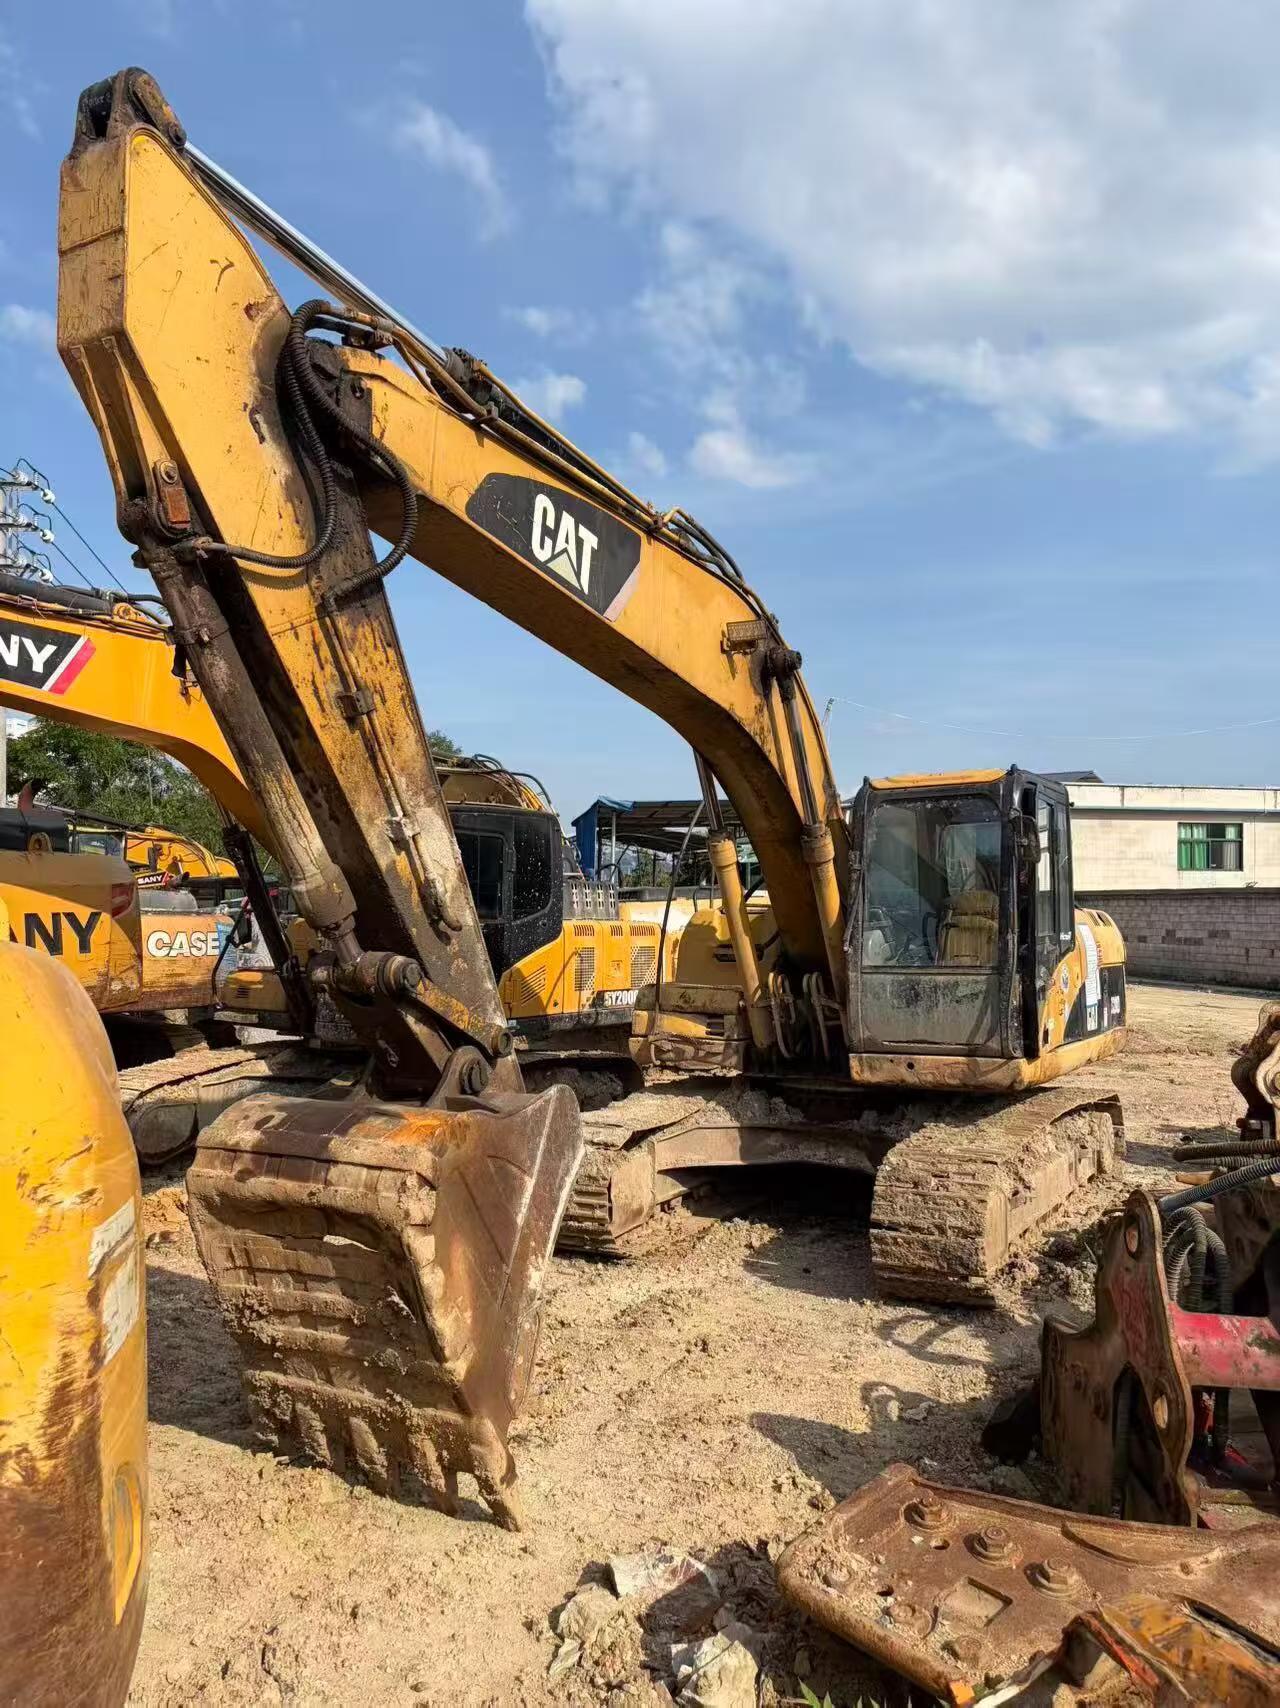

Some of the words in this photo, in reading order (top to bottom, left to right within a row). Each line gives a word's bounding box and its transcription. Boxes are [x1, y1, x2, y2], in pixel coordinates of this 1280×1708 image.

[531, 493, 598, 595] CAT
[137, 875, 162, 885] SANY
[9, 911, 102, 956] NY
[147, 931, 220, 957] CASE
